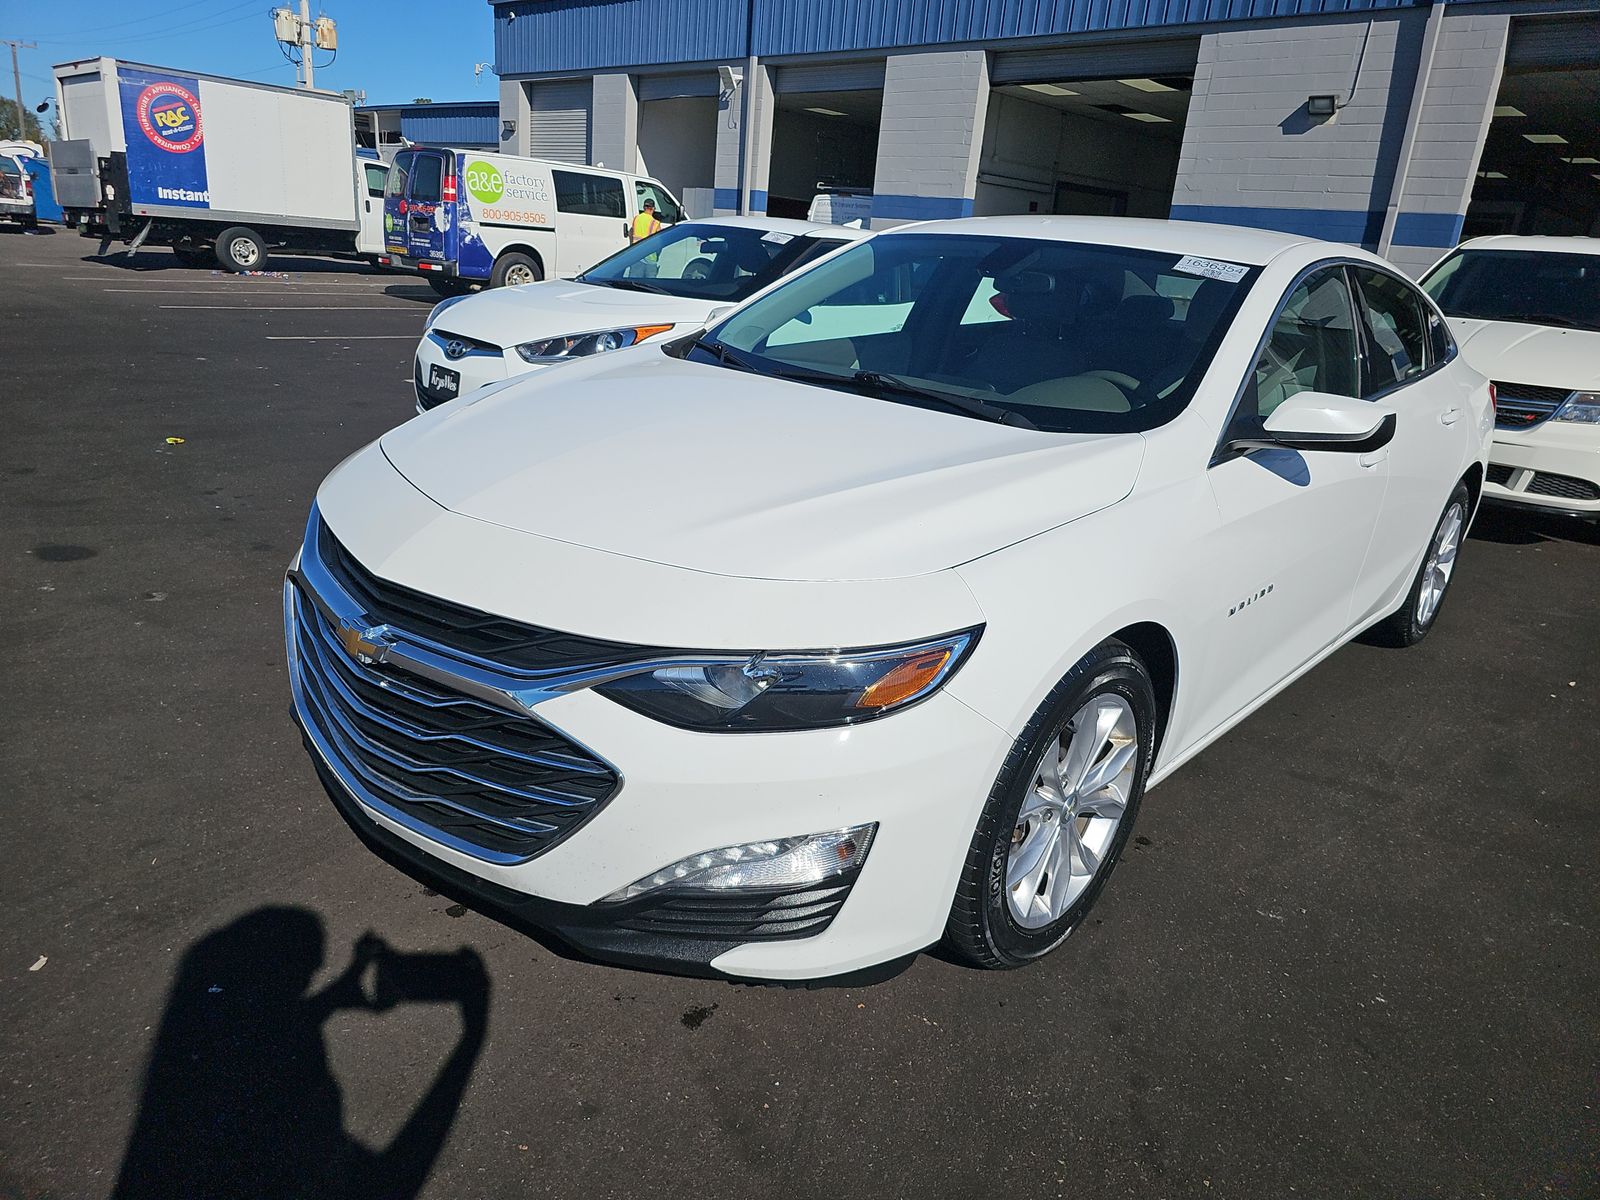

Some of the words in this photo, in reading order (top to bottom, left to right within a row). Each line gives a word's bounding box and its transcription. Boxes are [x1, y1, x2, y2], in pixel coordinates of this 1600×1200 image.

[152, 86, 189, 99] APPLIANCES
[140, 96, 151, 131] FURNITURE
[154, 106, 190, 127] RAC
[153, 135, 191, 151] COMPUTERS
[467, 170, 503, 193] a&e
[504, 170, 545, 191] factory
[158, 186, 210, 203] Instant
[506, 187, 548, 202] service
[1185, 258, 1244, 275] 1636354
[1228, 583, 1274, 618] MALIBU
